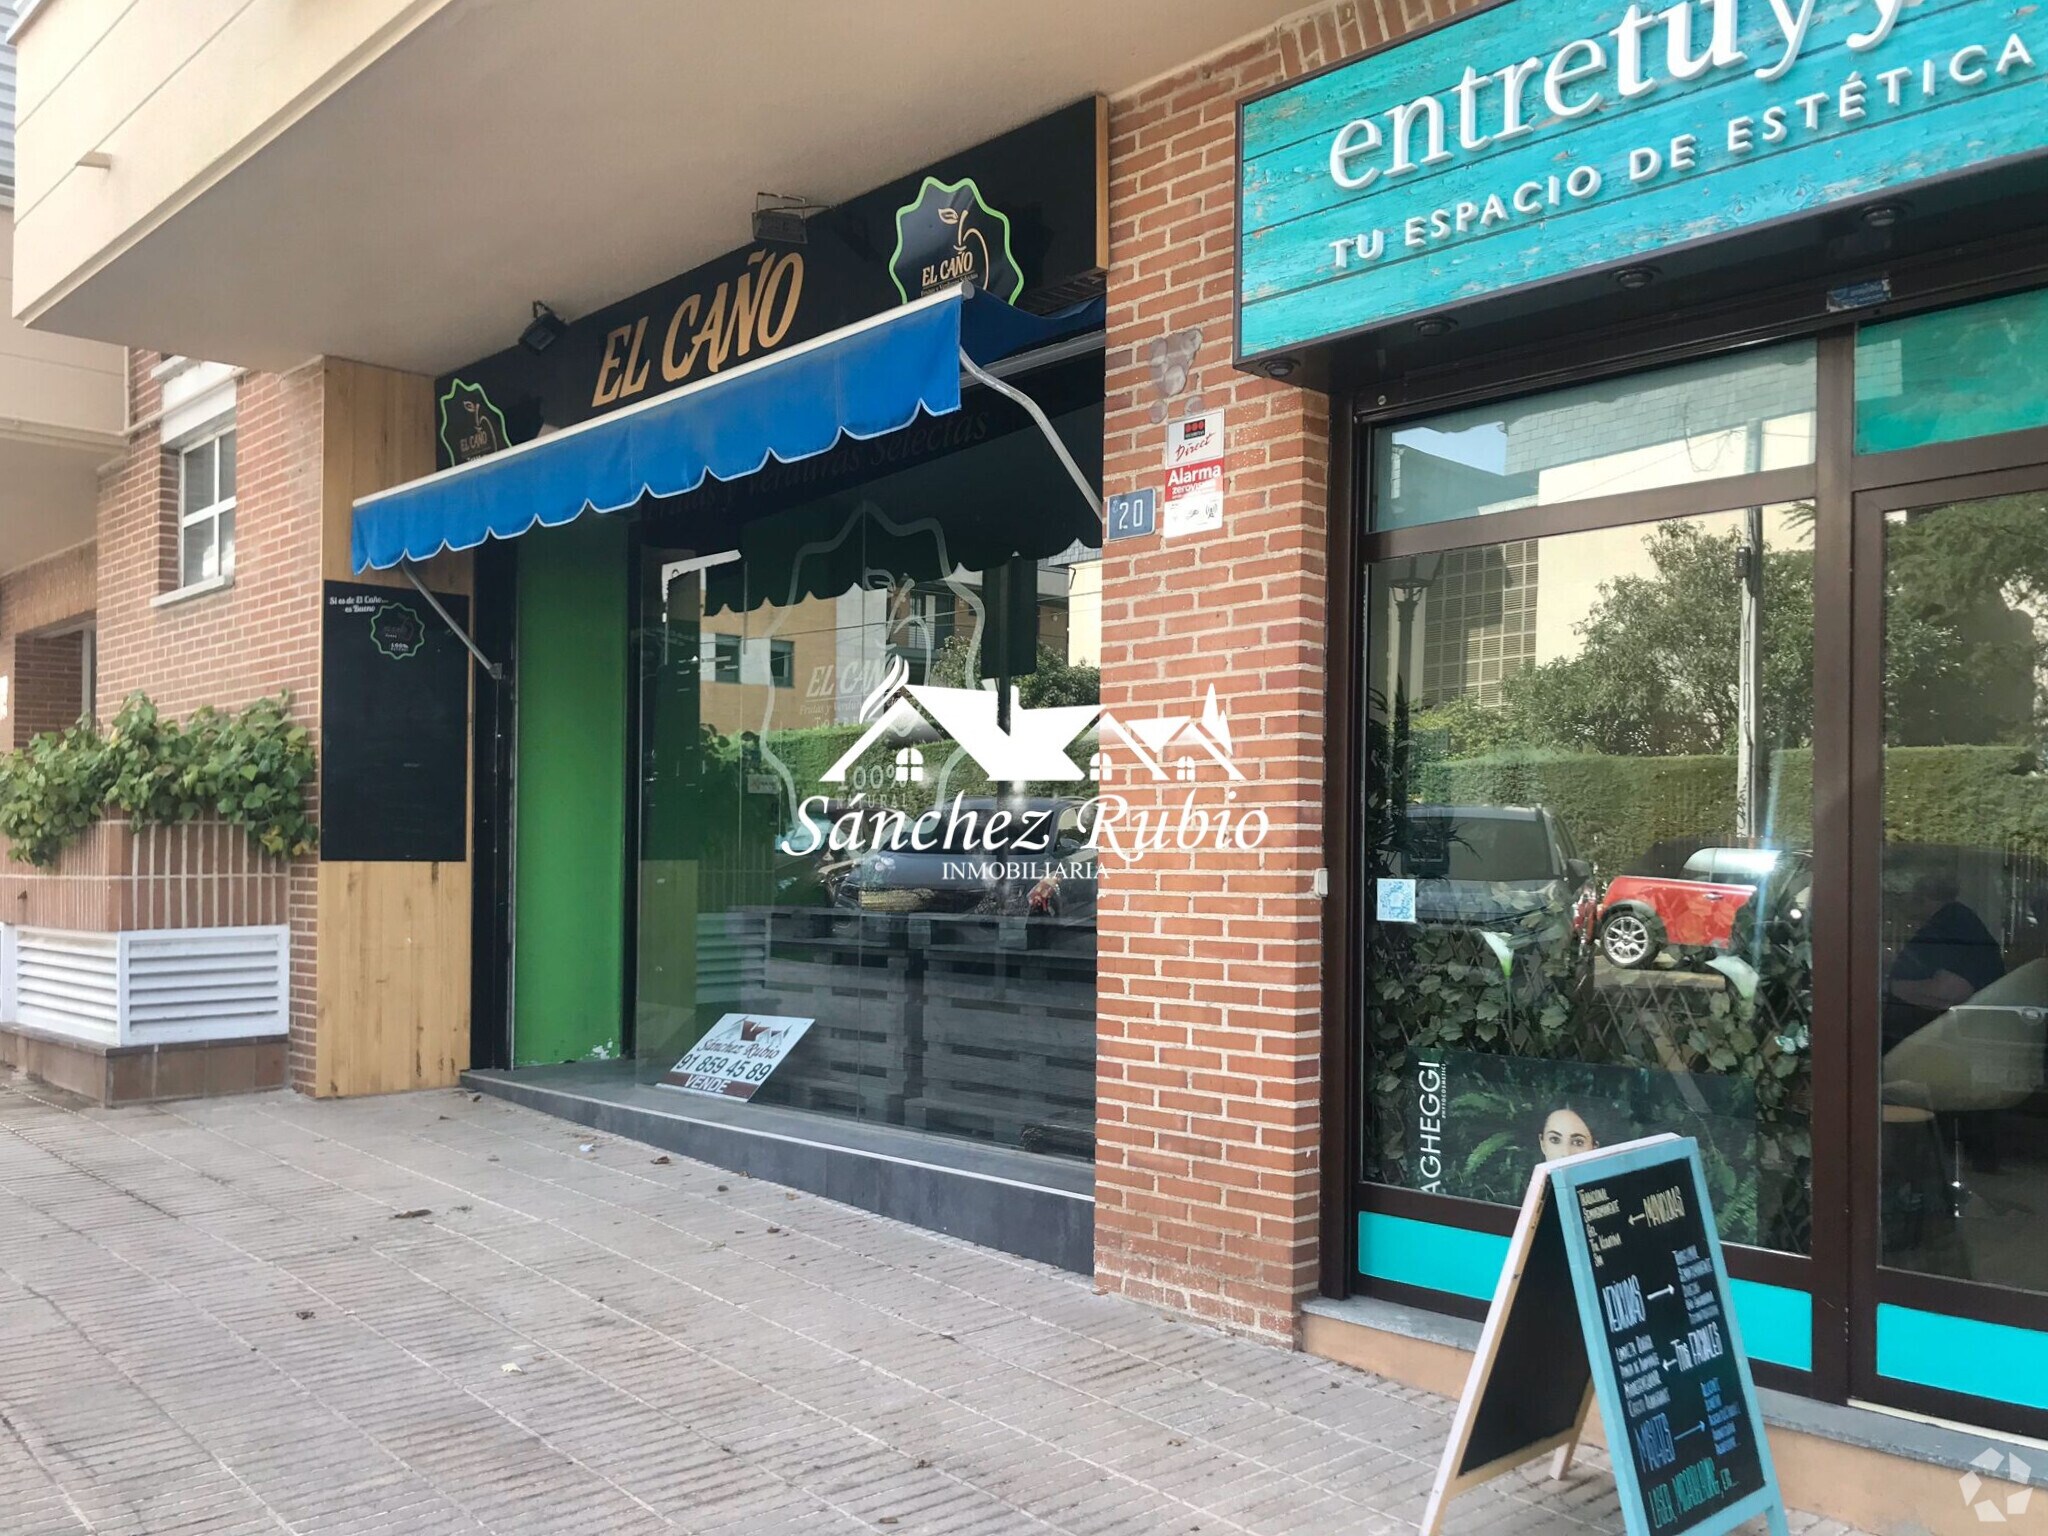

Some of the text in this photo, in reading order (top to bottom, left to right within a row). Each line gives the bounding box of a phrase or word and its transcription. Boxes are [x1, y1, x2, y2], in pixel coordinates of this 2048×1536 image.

[1329, 33, 2035, 269] TU ESPACIO DE ESTÉTICA
[922, 264, 938, 287] EL
[940, 251, 974, 279] CAÑO
[591, 248, 804, 408] EL CAÑO
[460, 437, 470, 453] EL
[1167, 464, 1223, 487] Alarma
[1119, 498, 1144, 530] 20
[806, 664, 835, 698] EL
[837, 764, 907, 791] 00%
[745, 1043, 780, 1060] Rubio
[676, 1053, 772, 1082] 91 859 45 89
[684, 1074, 732, 1094] VENDE
